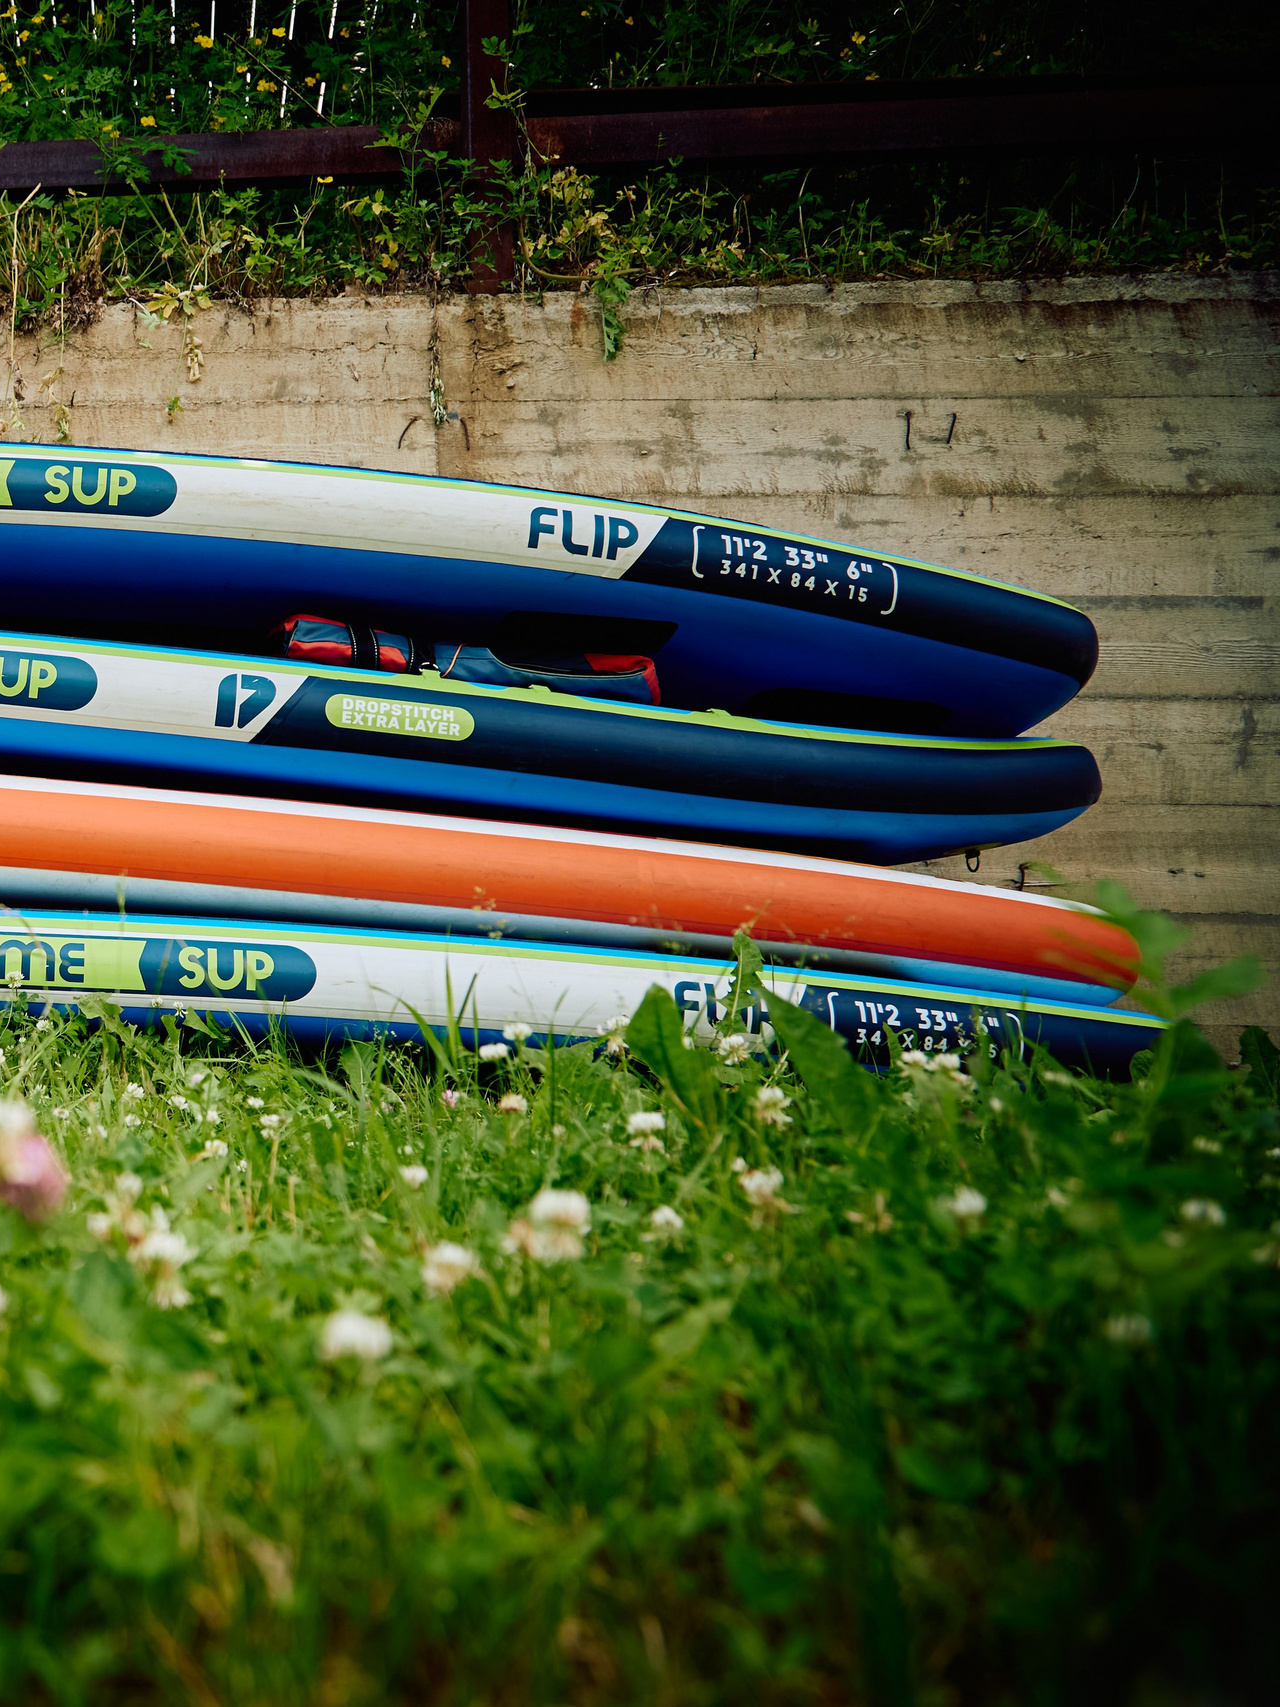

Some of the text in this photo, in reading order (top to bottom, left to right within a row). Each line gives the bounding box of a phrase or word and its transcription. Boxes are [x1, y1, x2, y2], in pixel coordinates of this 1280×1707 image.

[43, 465, 137, 506] SUP
[527, 506, 639, 560] FLIP
[719, 559, 869, 603] 341 X 84 X 15
[341, 710, 460, 737] EXTRA LAYER
[342, 697, 455, 723] DROPSTITCH
[178, 946, 275, 992] SUP
[856, 1028, 887, 1046] 34
[923, 1036, 948, 1053] 84
